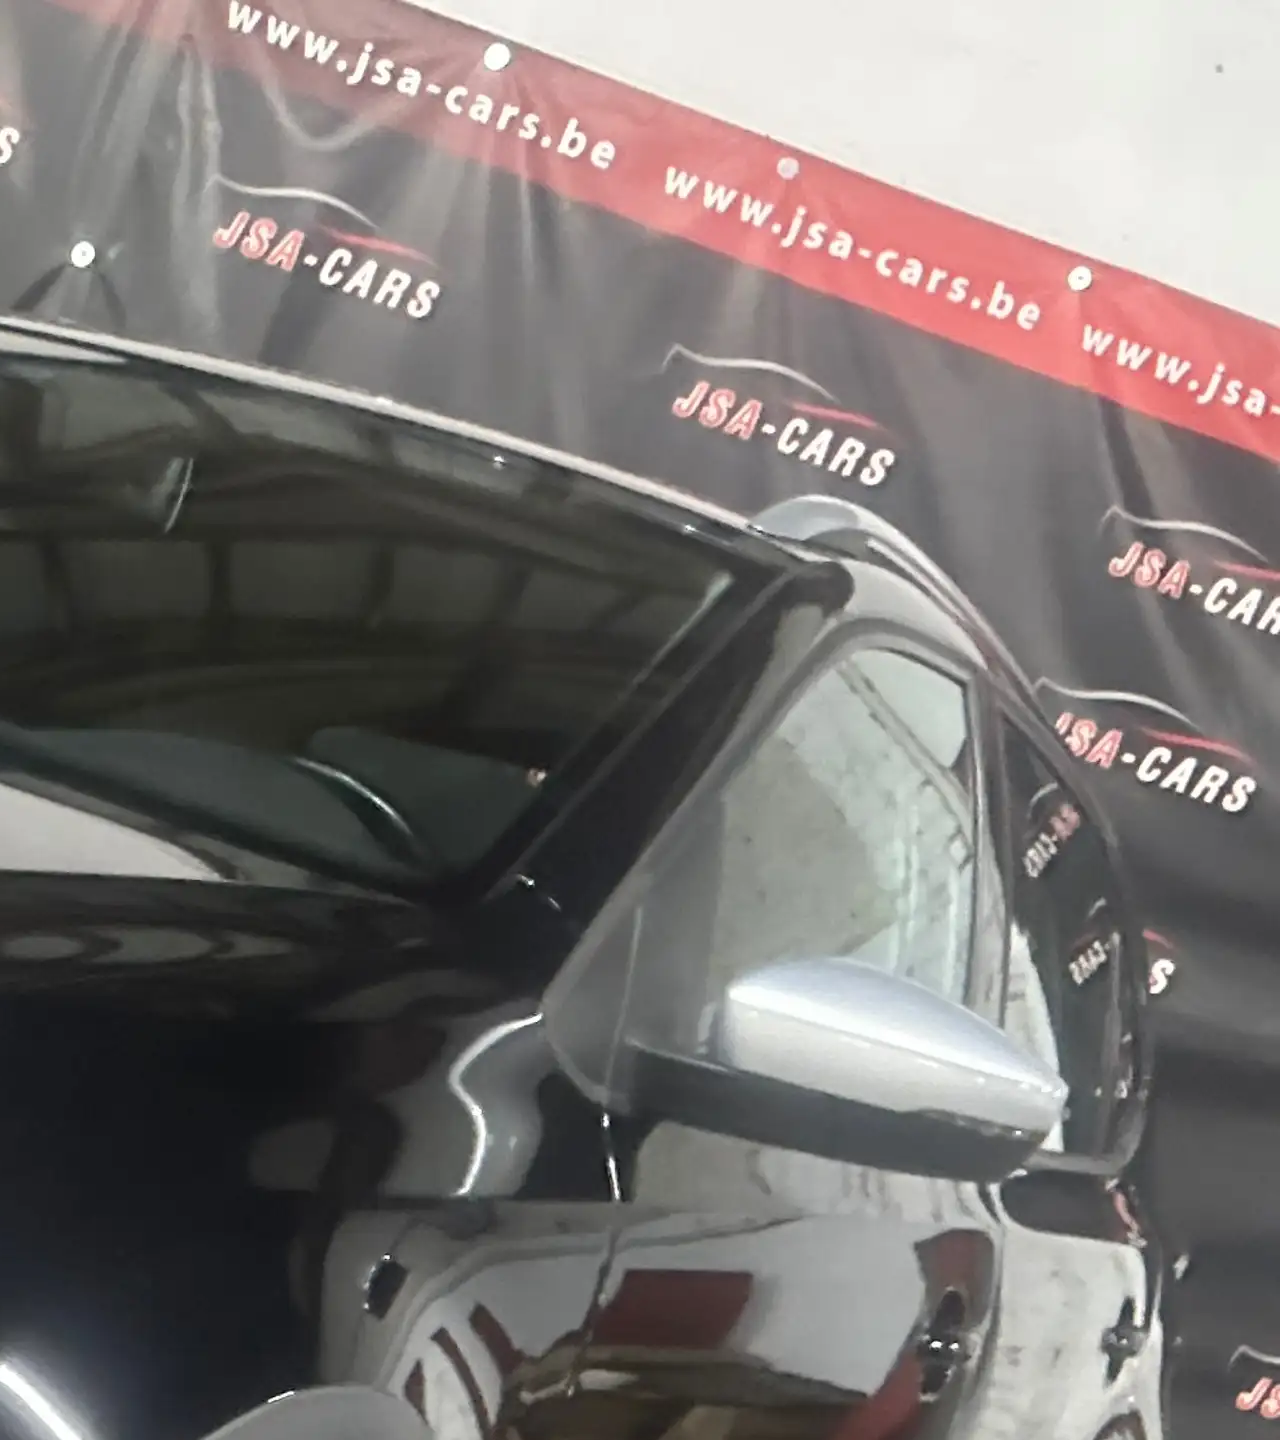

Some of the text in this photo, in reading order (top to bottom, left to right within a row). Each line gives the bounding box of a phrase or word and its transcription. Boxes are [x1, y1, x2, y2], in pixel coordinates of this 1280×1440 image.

[227, 0, 617, 170] www.jsa-cars.be
[213, 210, 440, 319] JSA-CARS
[663, 166, 1042, 330] www.jsa-cars.be
[671, 380, 896, 486] JSA-CARS
